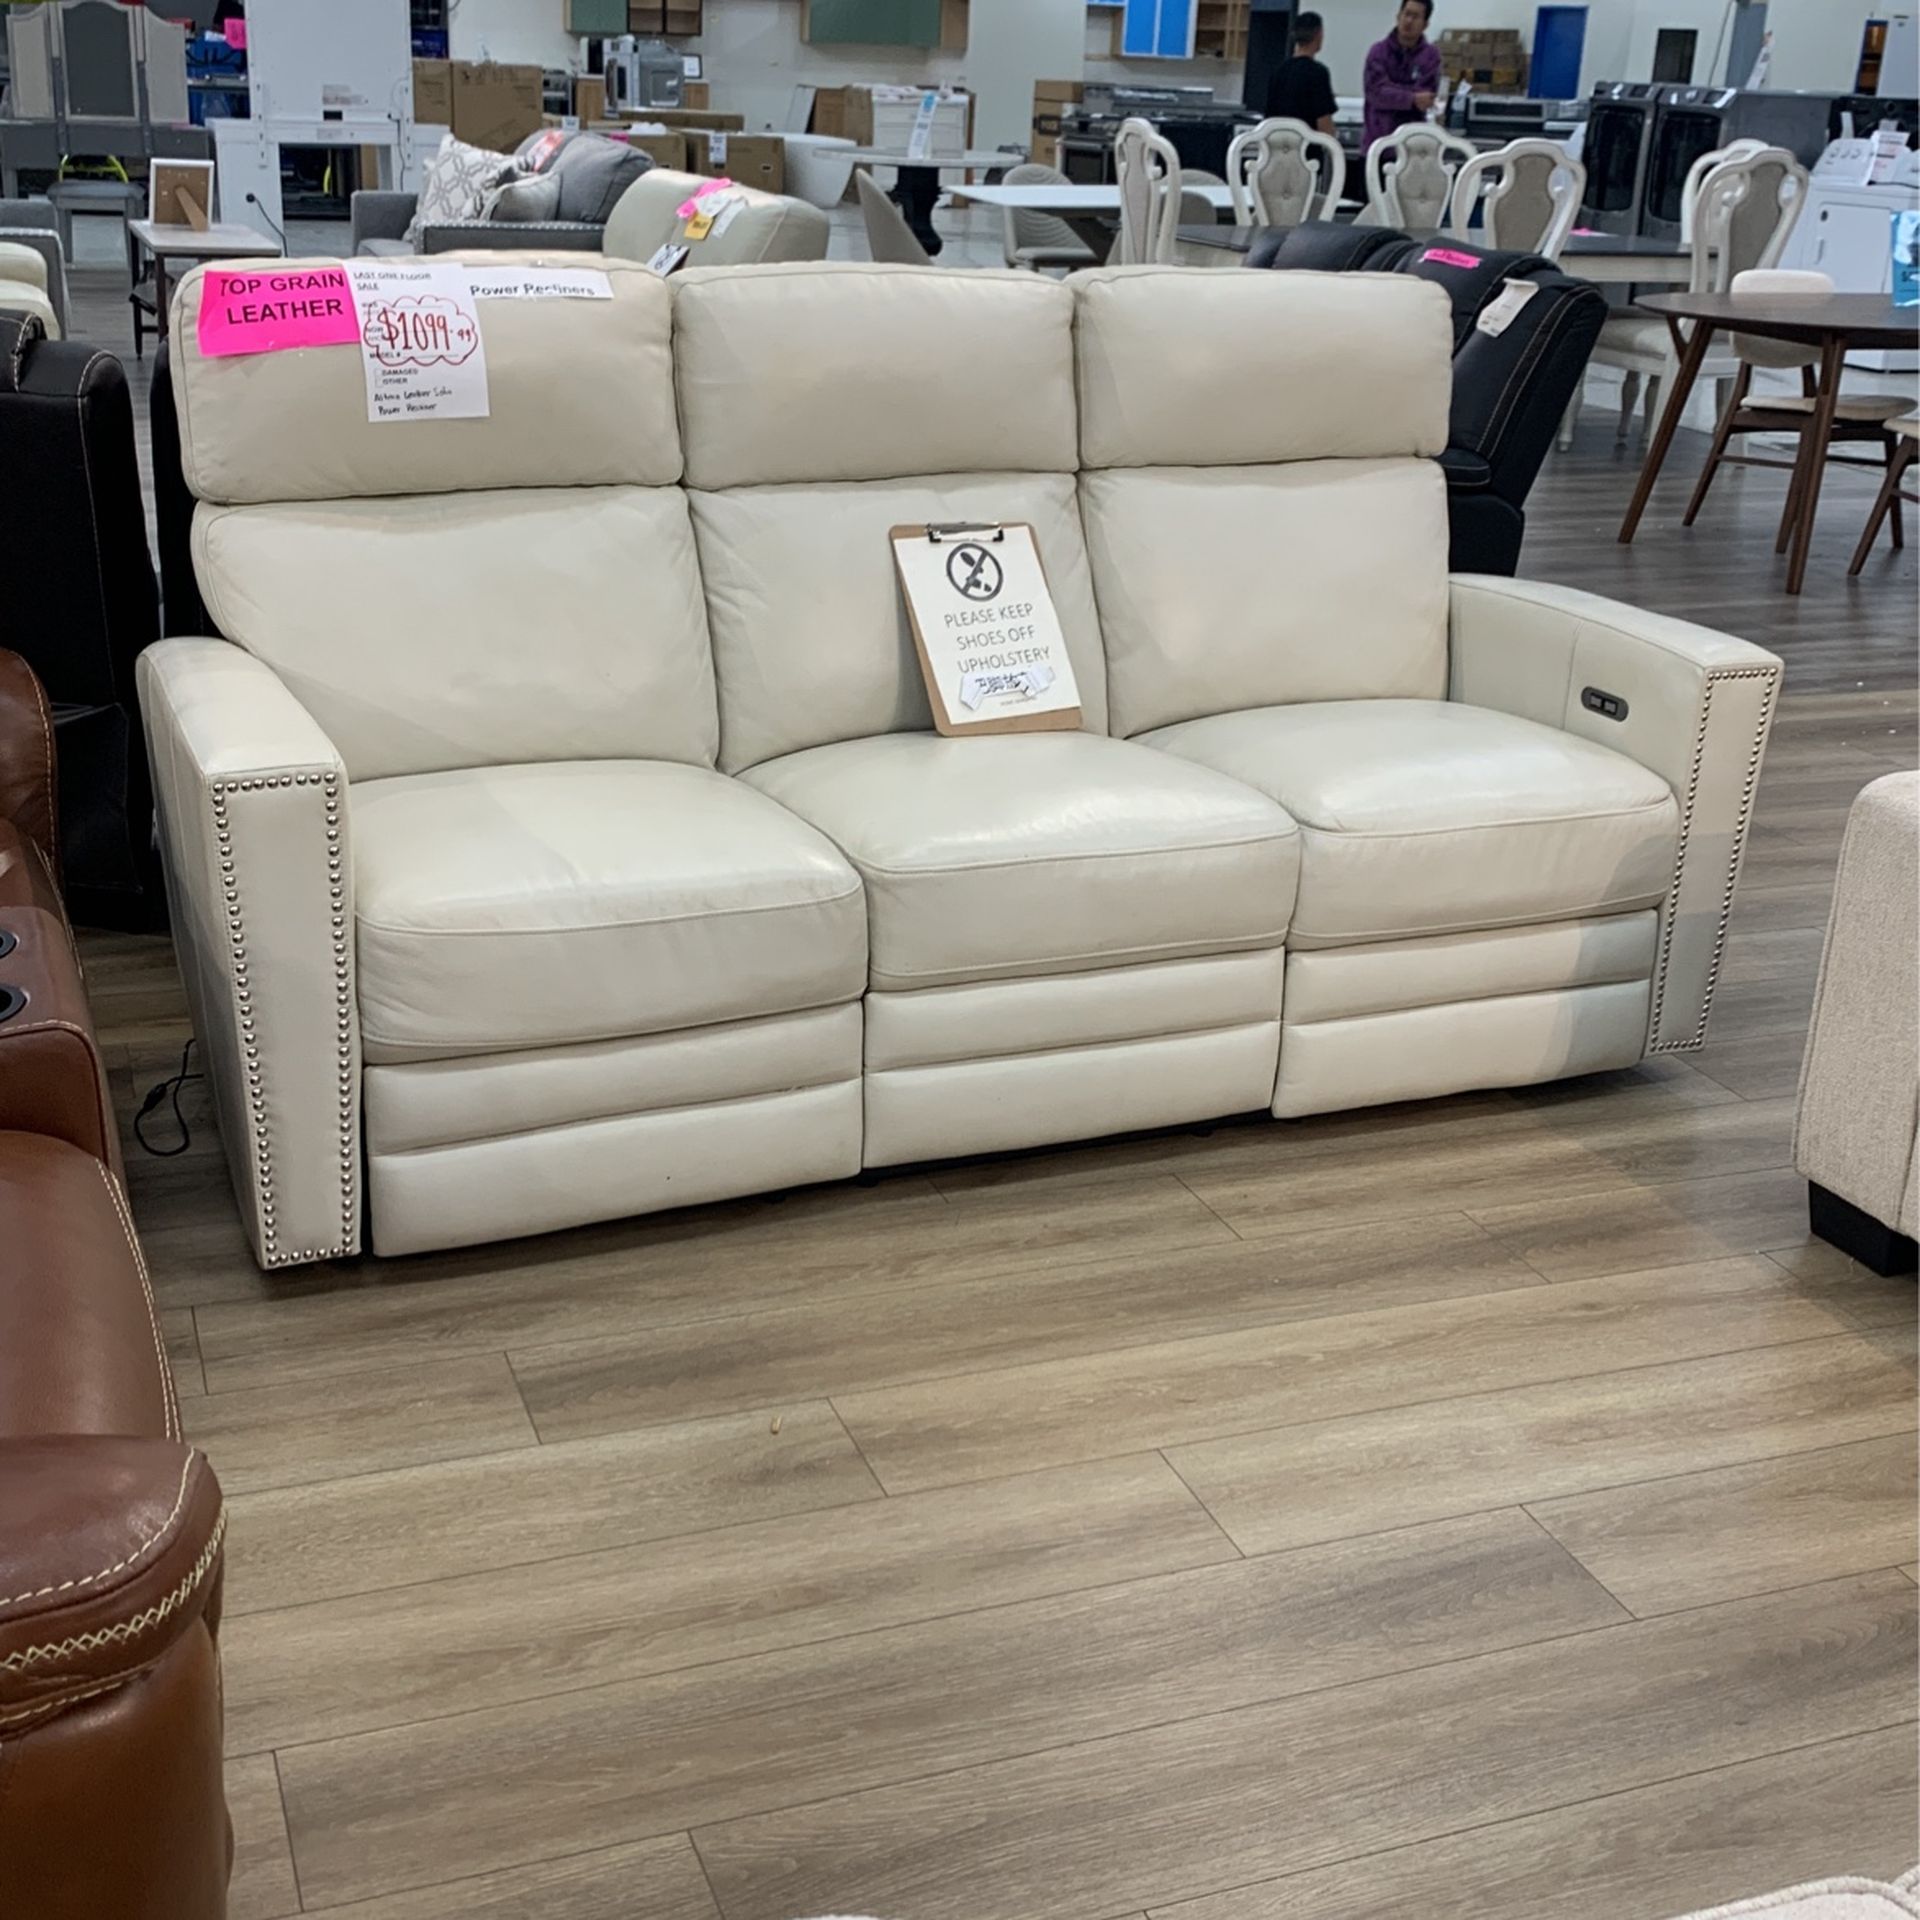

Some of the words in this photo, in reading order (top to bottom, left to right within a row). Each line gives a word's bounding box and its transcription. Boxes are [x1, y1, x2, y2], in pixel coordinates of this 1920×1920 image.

[220, 279, 261, 297] TOP
[270, 273, 344, 292] GRAIN
[357, 282, 379, 291] SALE
[470, 285, 519, 296] Power
[227, 299, 343, 325] LEATHER
[382, 377, 408, 385] OTHER
[944, 608, 997, 628] PLEASE
[999, 602, 1033, 620] KEEP
[956, 630, 1006, 651] SHOES
[1008, 625, 1035, 642] OFF
[957, 646, 1050, 673] UPHOLSTERY
